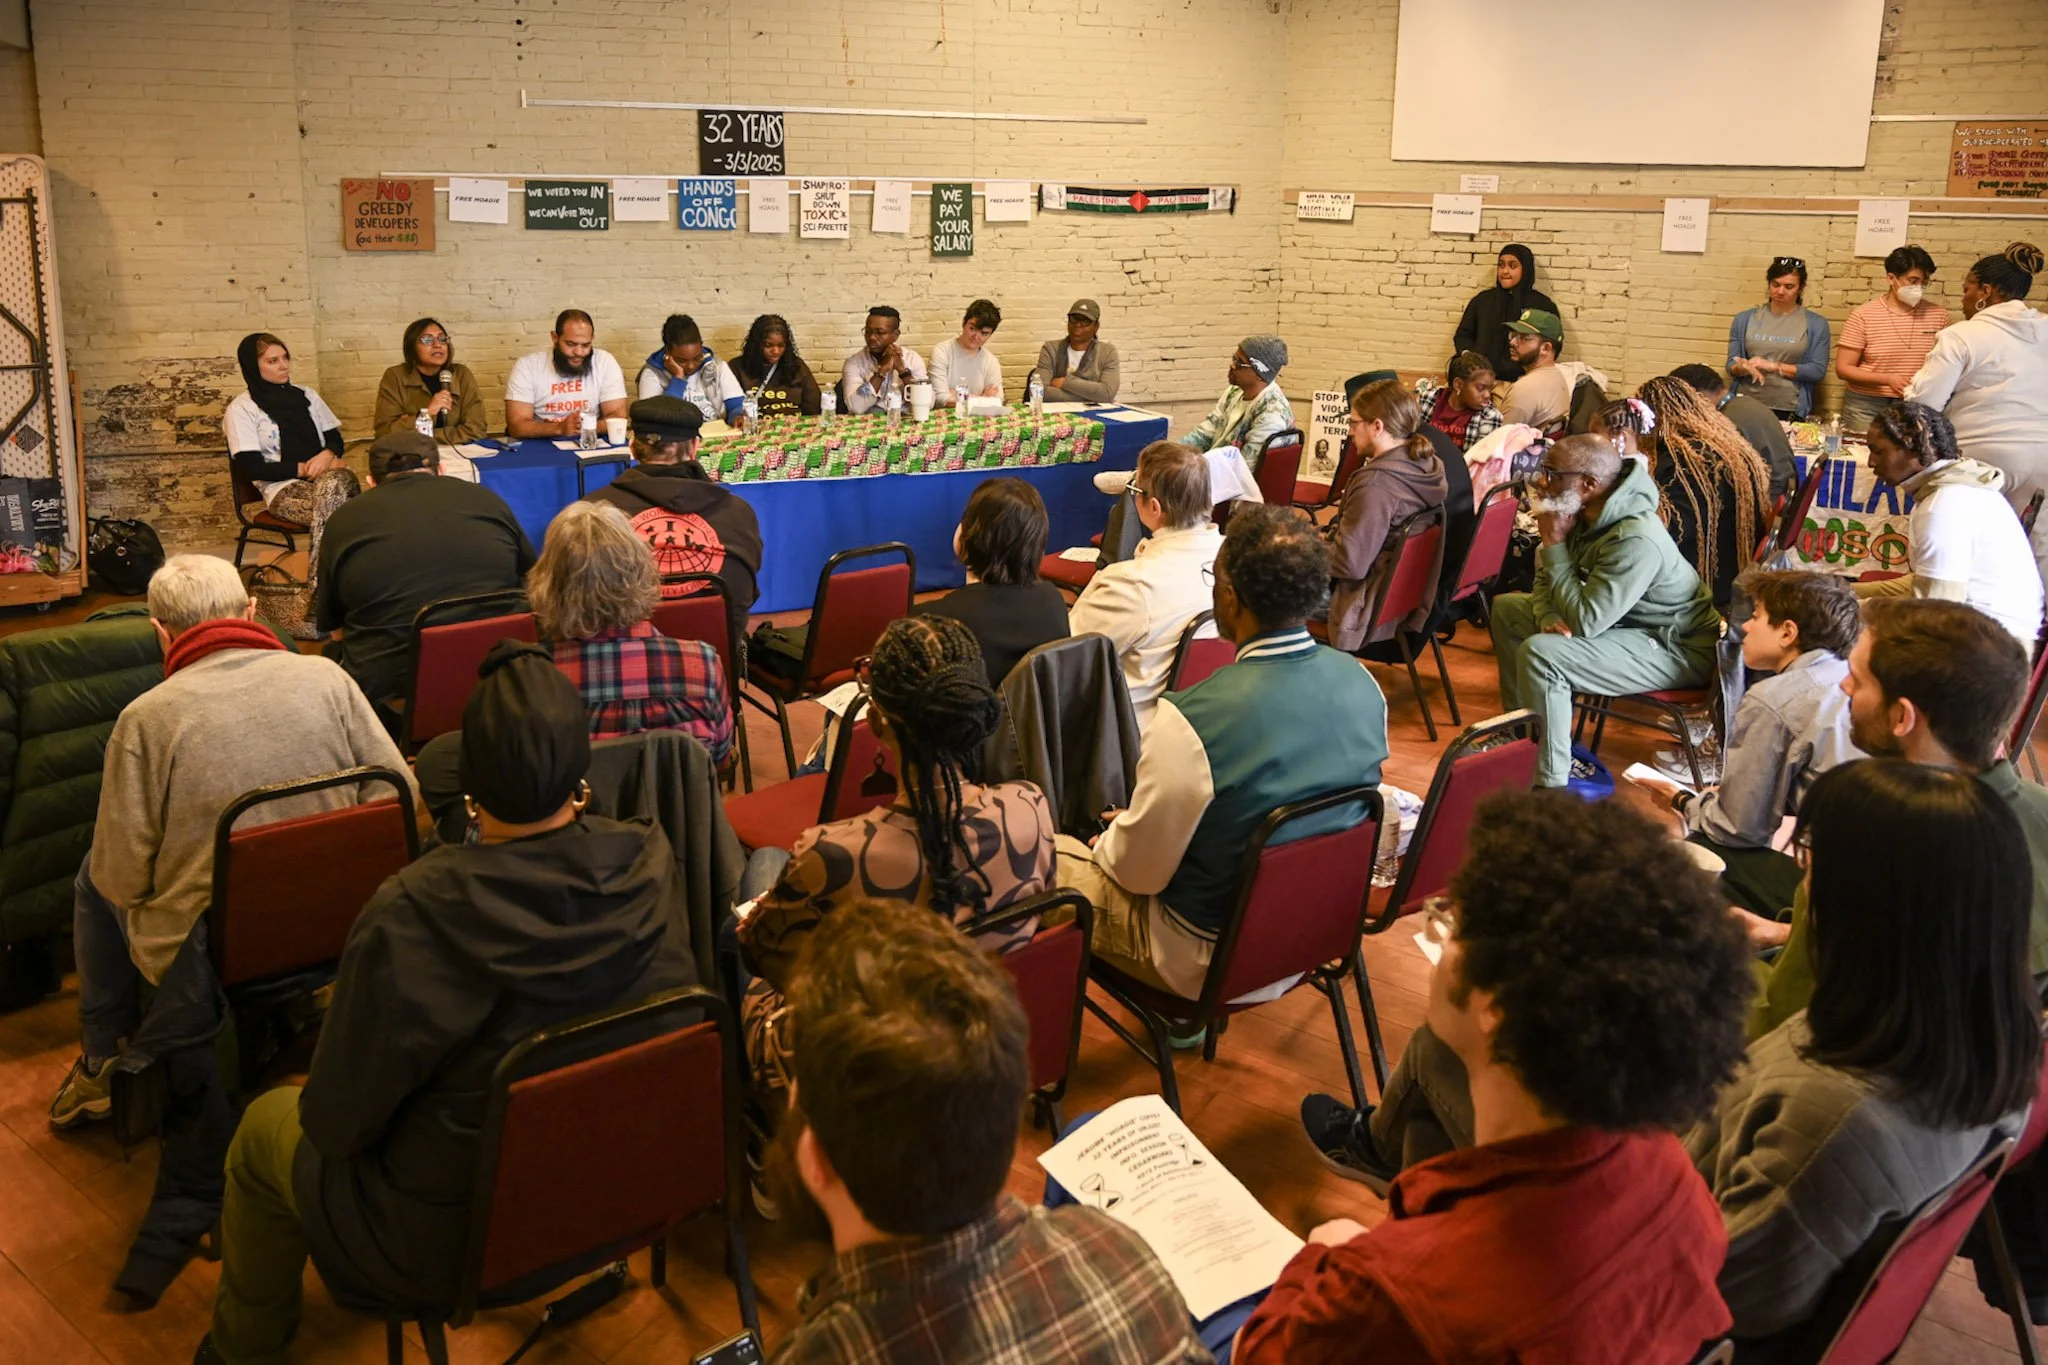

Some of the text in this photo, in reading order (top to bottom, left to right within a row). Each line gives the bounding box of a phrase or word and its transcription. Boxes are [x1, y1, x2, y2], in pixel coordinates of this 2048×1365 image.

[703, 114, 785, 148] 32 YEARS
[376, 181, 412, 201] NO
[683, 180, 735, 196] HANDS
[803, 180, 846, 190] SHAPIRO:
[528, 186, 604, 199] WE VOTED YOU IN
[814, 192, 836, 201] SHUT
[941, 189, 963, 203] WE
[692, 198, 724, 206] OFF
[358, 202, 413, 216] GREEDY
[529, 209, 541, 218] WE
[578, 207, 594, 216] YOU
[803, 210, 839, 220] TOXIC
[939, 204, 963, 218] PAY
[355, 218, 419, 229] DEVELOPERS
[579, 217, 607, 228] OUT
[803, 223, 816, 232] SCI
[936, 220, 971, 234] YOUR
[375, 234, 394, 243] their
[934, 234, 973, 252] SALARY
[551, 379, 582, 395] FREE
[1315, 393, 1338, 402] STOP
[1315, 415, 1335, 424] AND
[1077, 1137, 1105, 1160] JEROME
